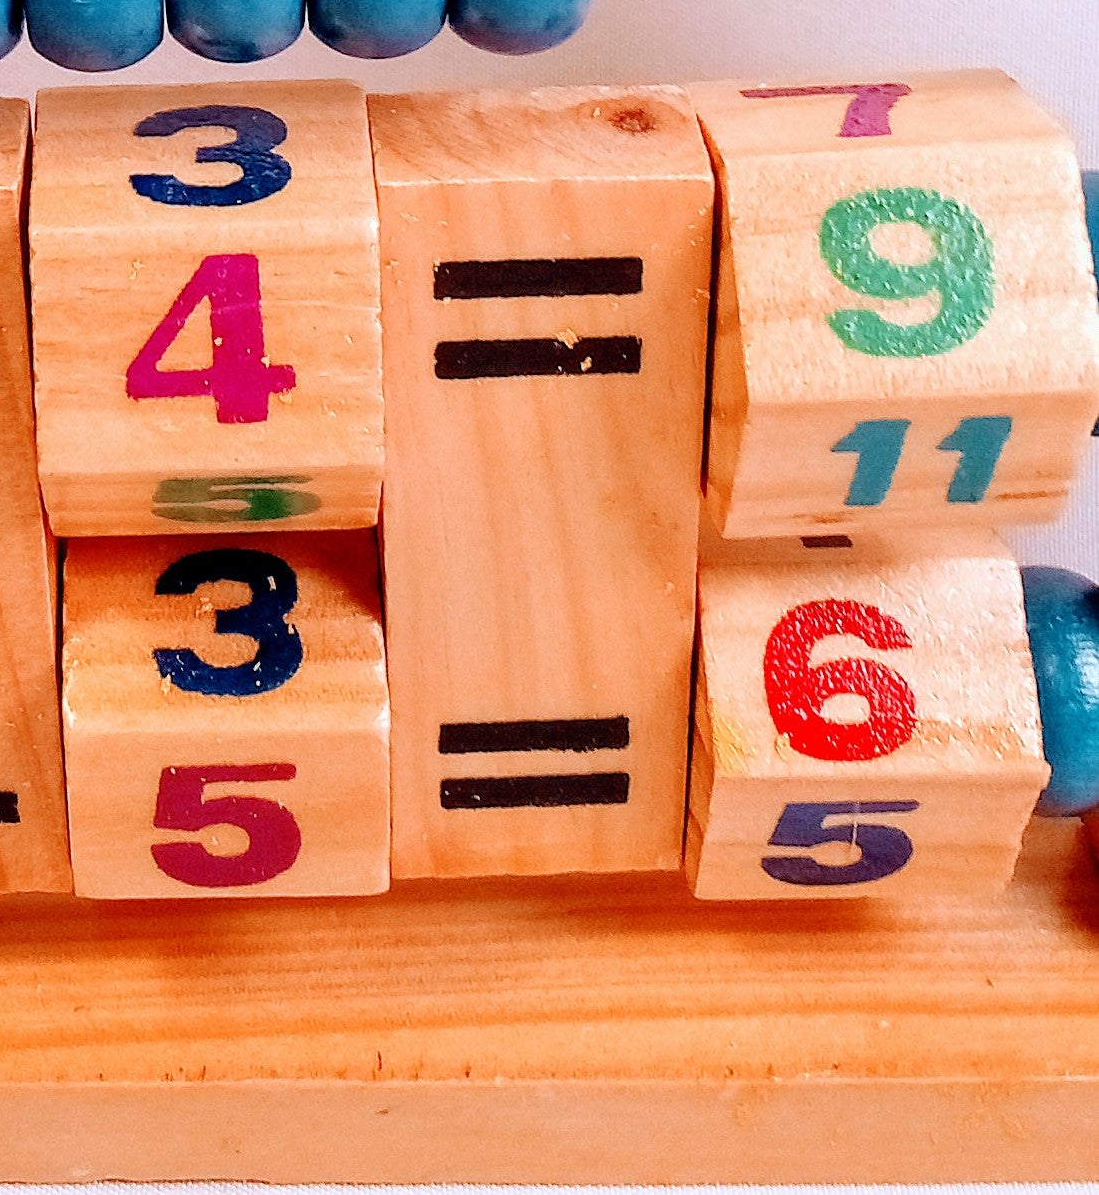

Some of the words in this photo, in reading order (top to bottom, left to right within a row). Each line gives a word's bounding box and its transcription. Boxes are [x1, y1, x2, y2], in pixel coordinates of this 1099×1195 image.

[129, 104, 292, 207] 3
[739, 82, 912, 138] 7
[125, 253, 297, 424] 4
[819, 185, 996, 358] 9
[150, 475, 322, 522] 5
[830, 416, 1014, 506] 11
[152, 548, 304, 697] 3
[763, 599, 917, 761] 6
[150, 763, 302, 888] 5
[761, 799, 920, 886] 5
